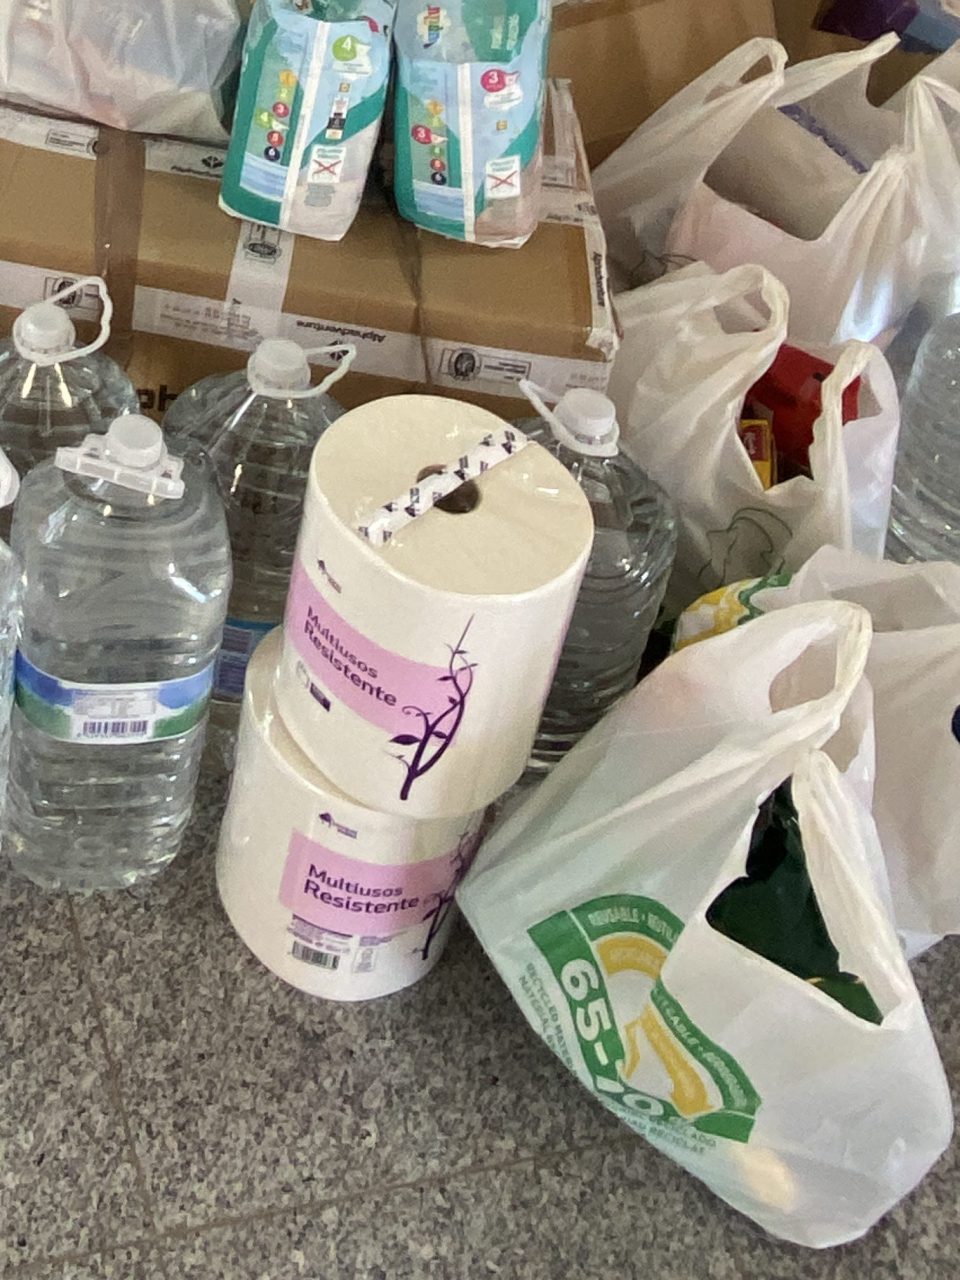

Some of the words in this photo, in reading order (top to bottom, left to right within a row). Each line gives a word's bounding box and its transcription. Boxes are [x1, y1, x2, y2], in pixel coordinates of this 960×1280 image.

[341, 36, 353, 51] 4
[489, 71, 499, 84] 3
[296, 320, 387, 344] Alphadventure
[307, 606, 378, 679] Multiusos
[304, 620, 398, 707] Resistente
[303, 878, 421, 915] Resistente
[307, 863, 404, 898] Multiusos
